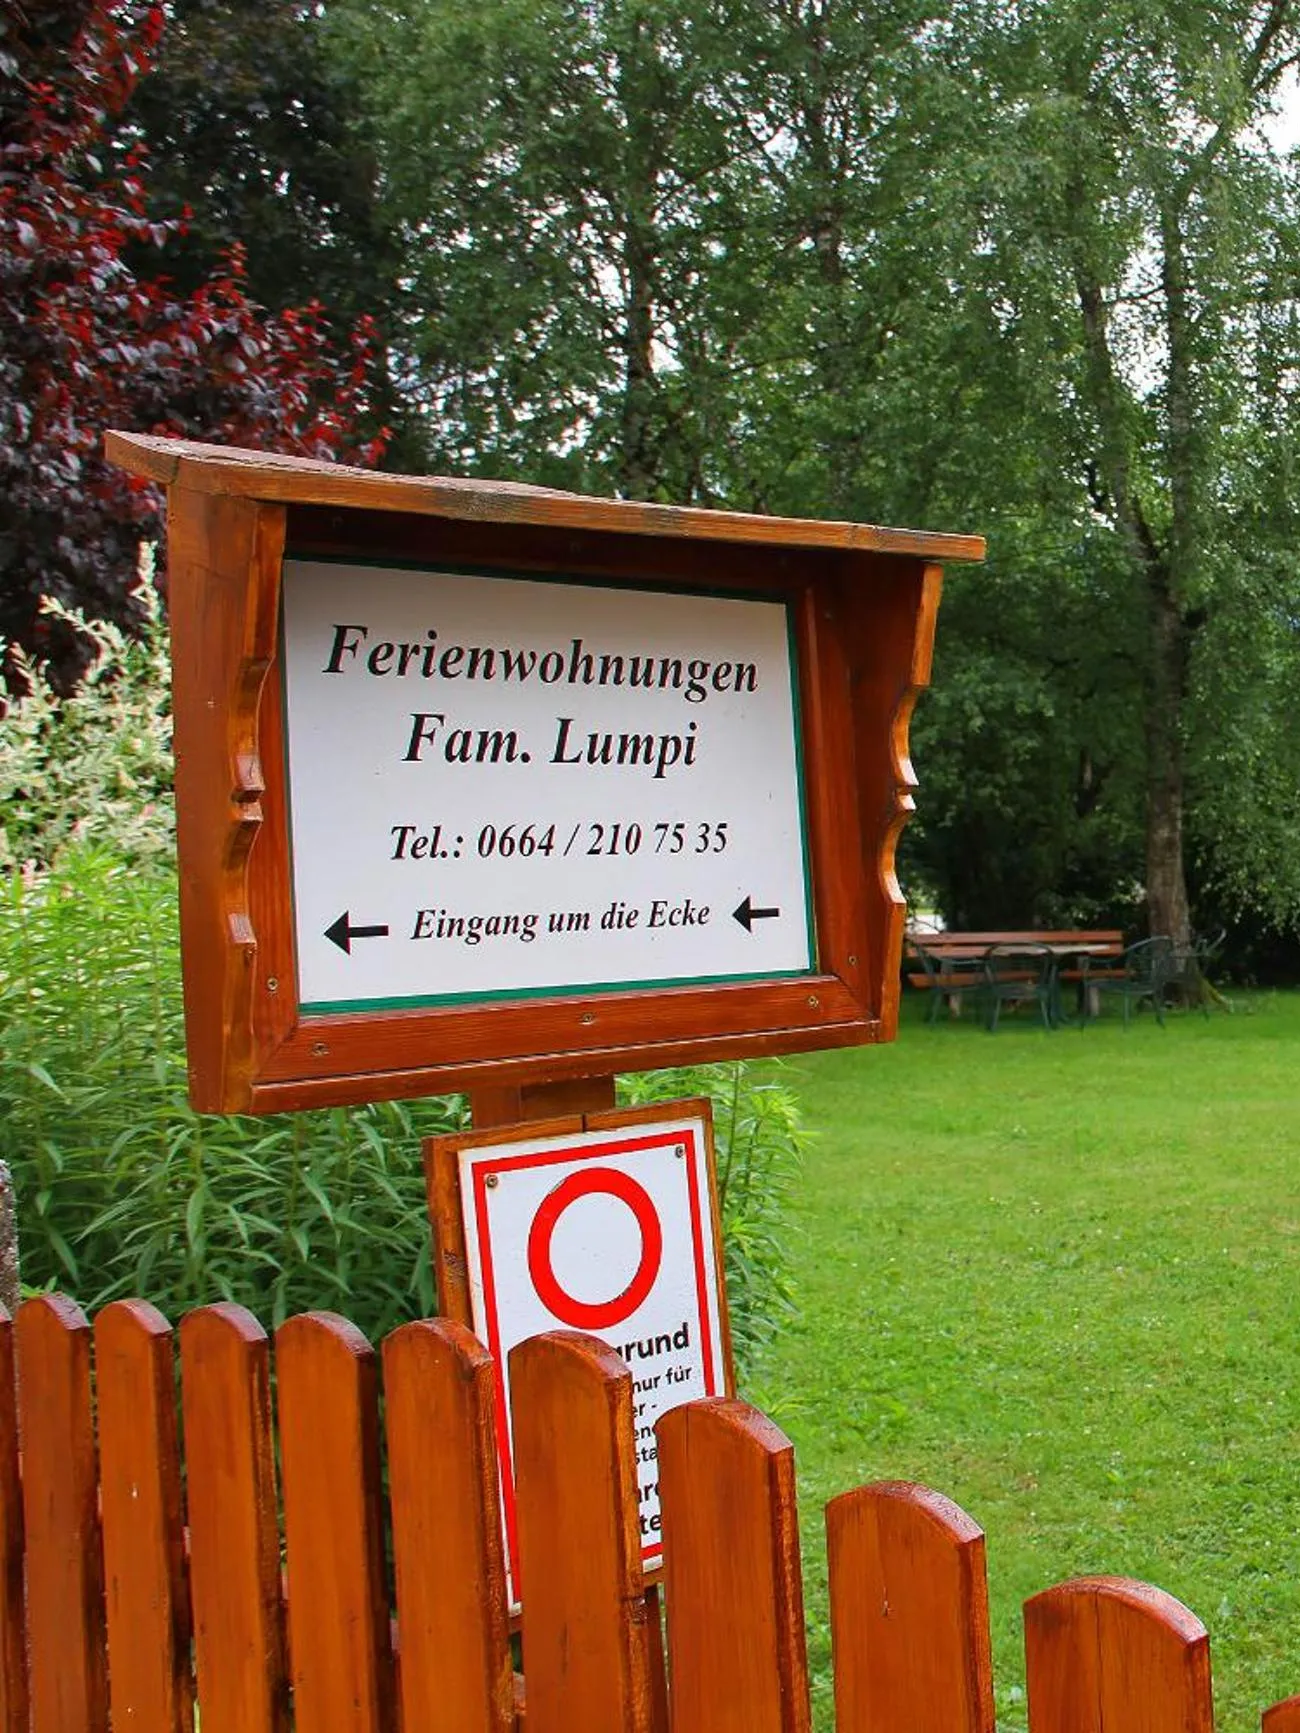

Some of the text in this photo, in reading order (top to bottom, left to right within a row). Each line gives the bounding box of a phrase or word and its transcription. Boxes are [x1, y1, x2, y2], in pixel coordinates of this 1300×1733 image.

[322, 623, 759, 703] Ferienwohnungen
[401, 712, 698, 779] Fam. Lumpi
[390, 825, 465, 860] Tel.:
[477, 823, 556, 858] 0664
[586, 822, 643, 856] 210
[653, 822, 686, 855] 75
[695, 821, 728, 854] 35
[410, 899, 711, 945] Eingang um die Ecke
[665, 1365, 692, 1385] für
